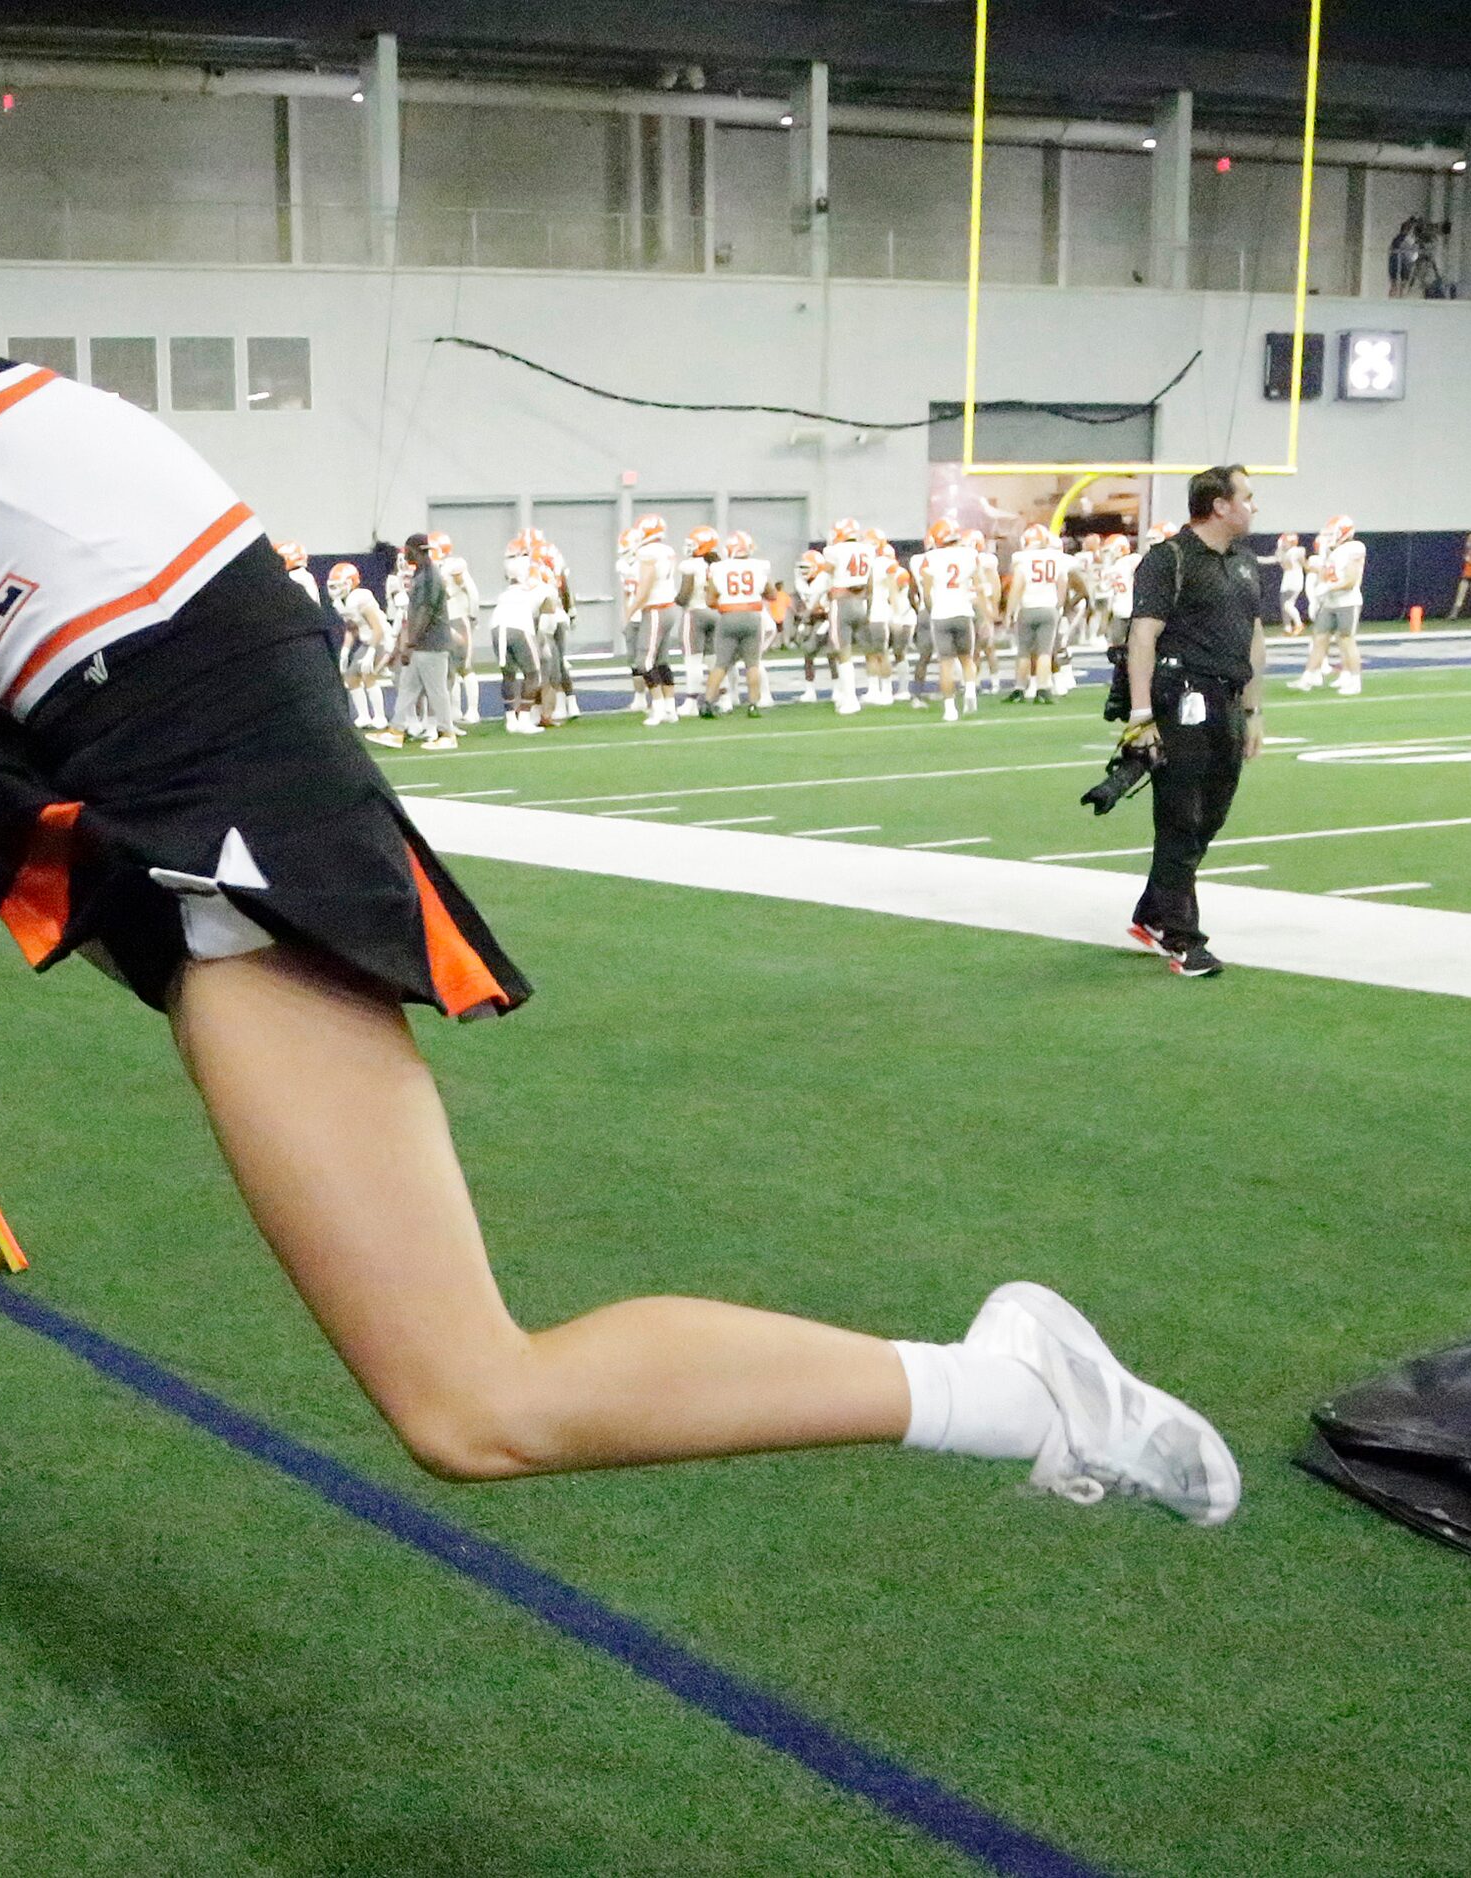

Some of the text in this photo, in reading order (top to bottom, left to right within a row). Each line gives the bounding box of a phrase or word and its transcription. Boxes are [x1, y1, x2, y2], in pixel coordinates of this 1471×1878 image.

[846, 553, 868, 577] 46
[946, 563, 960, 589] 2
[1031, 559, 1056, 584] 50
[726, 570, 755, 597] 69
